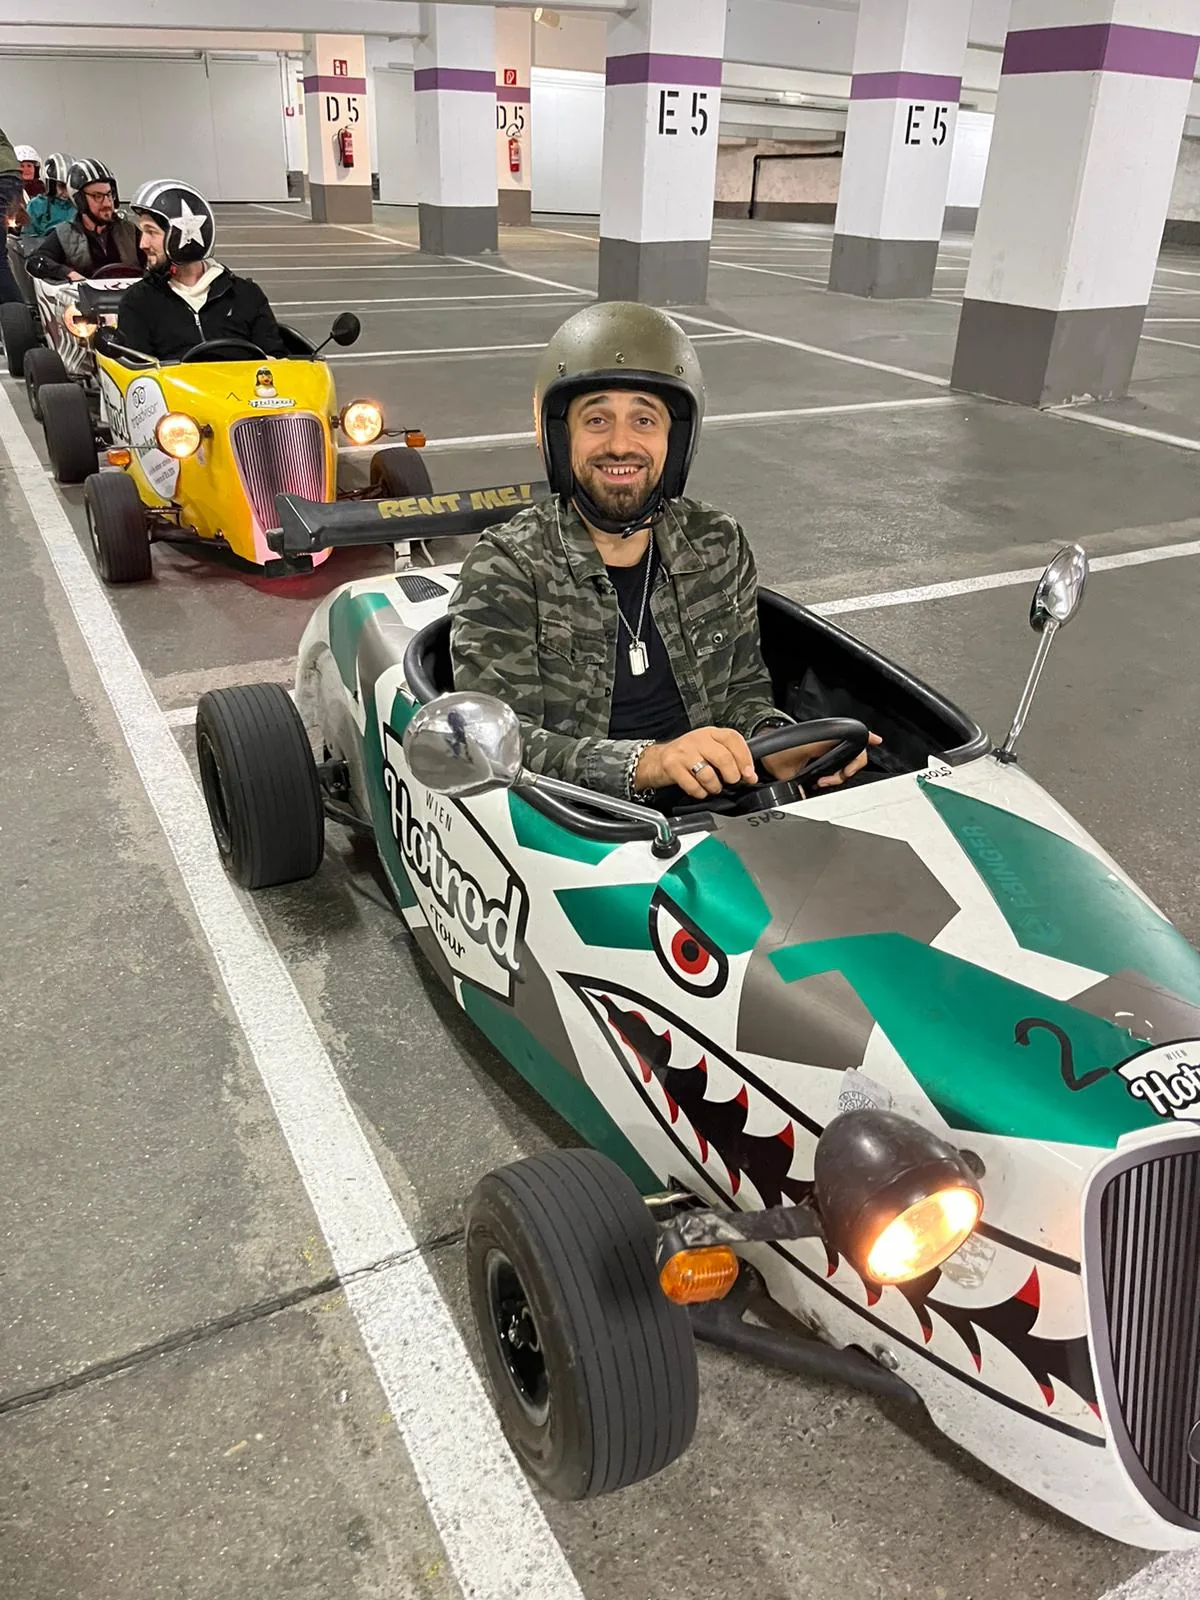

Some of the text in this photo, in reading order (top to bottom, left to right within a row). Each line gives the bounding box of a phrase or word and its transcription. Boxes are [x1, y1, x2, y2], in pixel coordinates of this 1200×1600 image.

[326, 96, 360, 122] D 5
[496, 105, 525, 131] D 5
[659, 90, 708, 136] E 5
[905, 105, 948, 146] E 5
[378, 484, 533, 519] RENT ME!
[923, 766, 952, 780] STOP
[425, 789, 453, 832] WIEN
[746, 810, 786, 828] GAS
[384, 766, 521, 971] Hotrod
[430, 903, 466, 959] Tour
[1014, 1017, 1111, 1091] 2
[1164, 1048, 1188, 1061] WIEN
